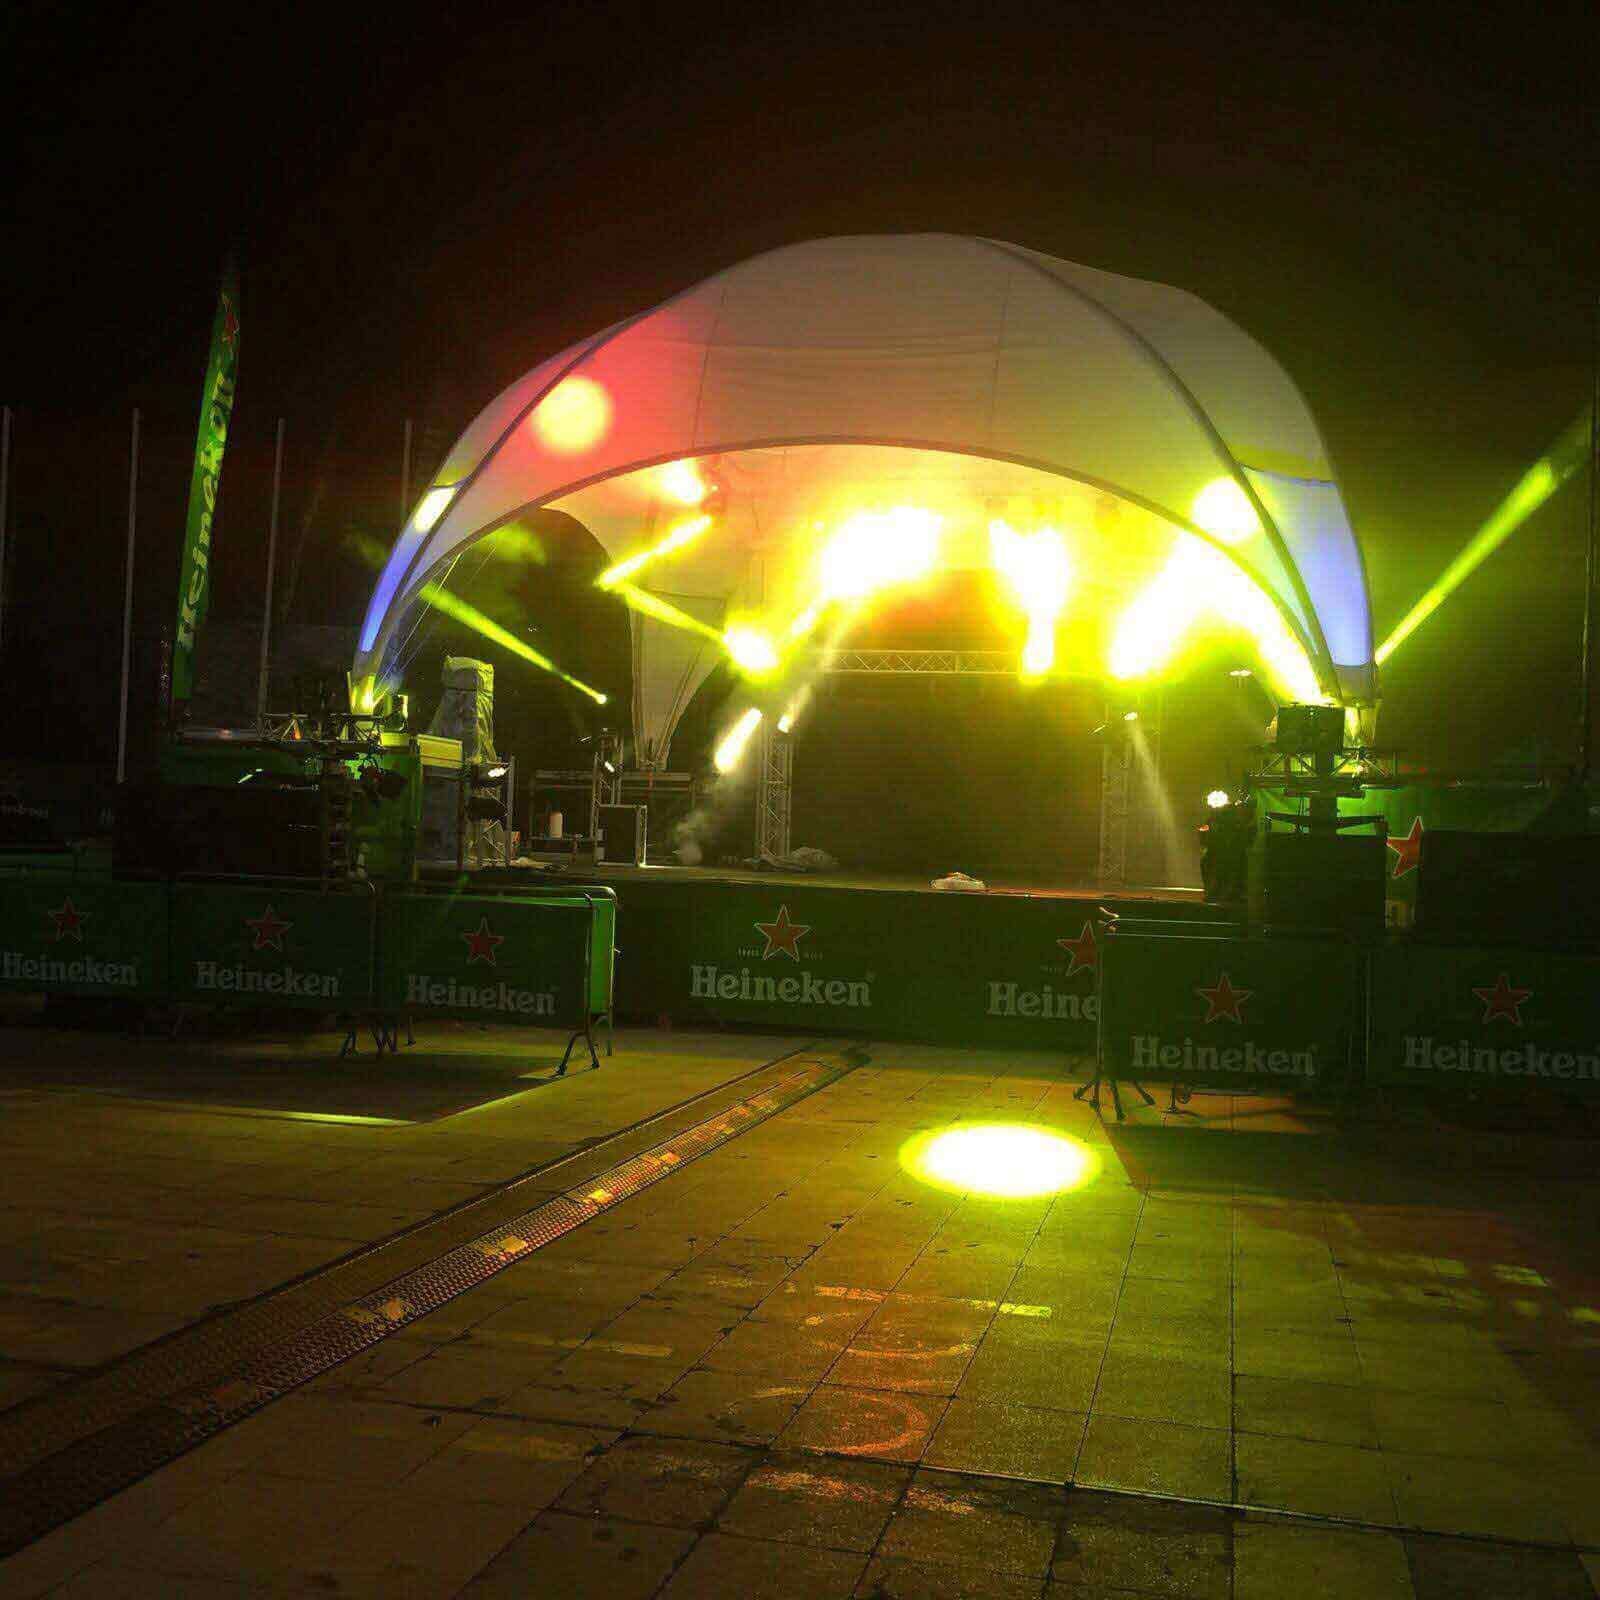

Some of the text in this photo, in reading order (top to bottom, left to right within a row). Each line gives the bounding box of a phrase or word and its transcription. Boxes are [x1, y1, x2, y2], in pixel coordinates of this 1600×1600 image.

[1, 951, 138, 987] Heineken
[194, 960, 340, 997] Heineken
[689, 964, 872, 1007] Heineken
[405, 974, 556, 1015] Heineken
[1131, 1035, 1316, 1077] Heineken
